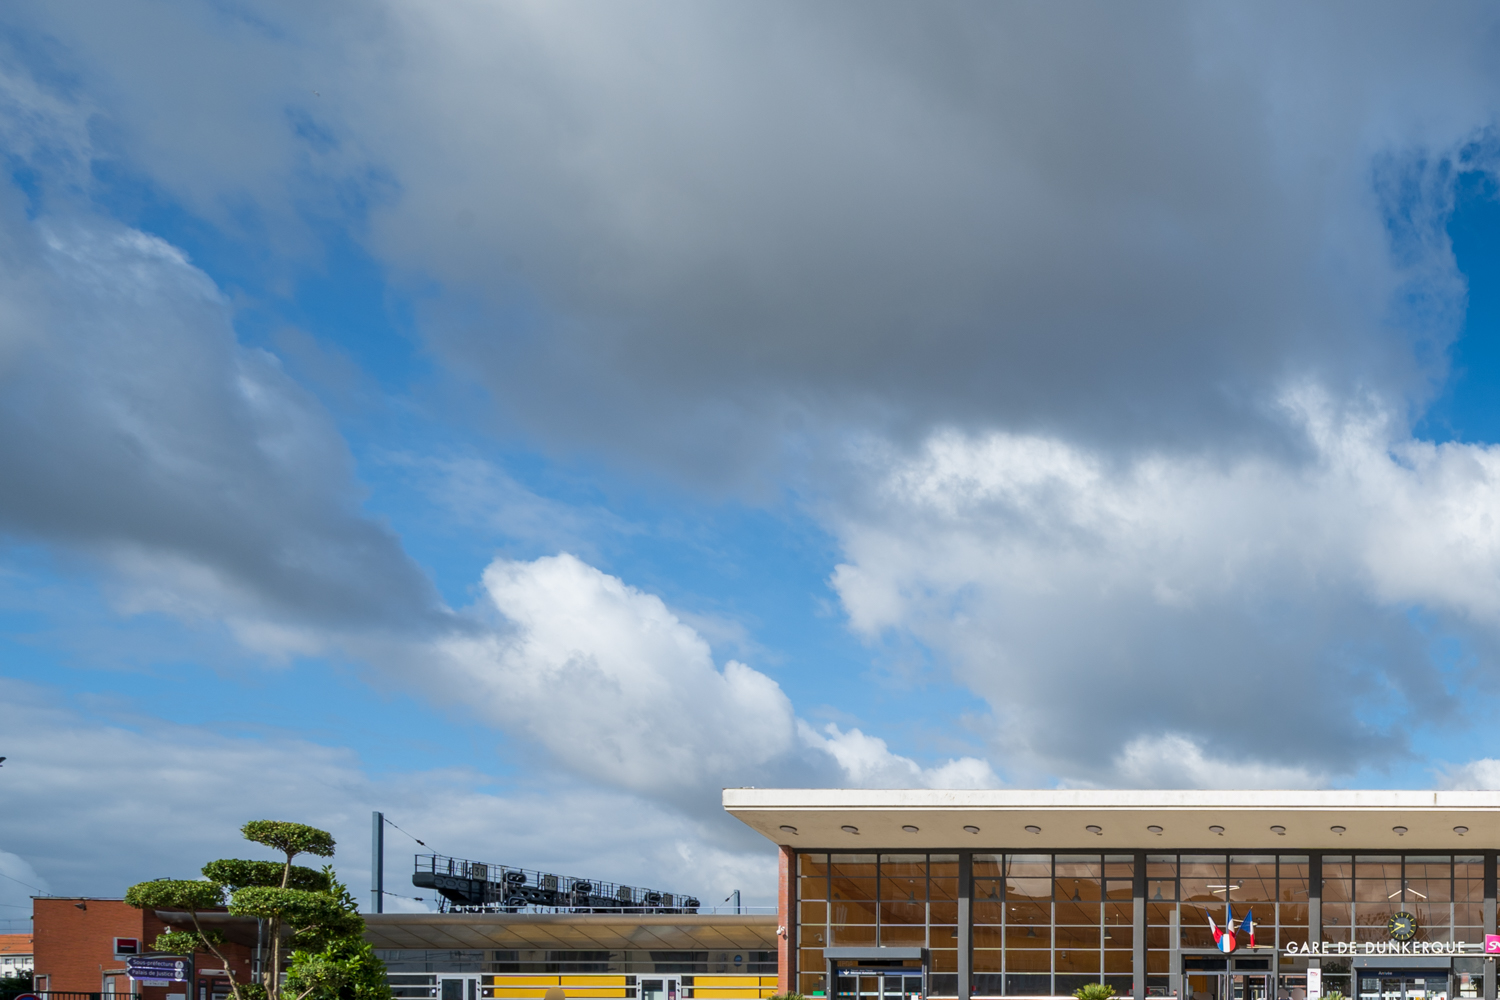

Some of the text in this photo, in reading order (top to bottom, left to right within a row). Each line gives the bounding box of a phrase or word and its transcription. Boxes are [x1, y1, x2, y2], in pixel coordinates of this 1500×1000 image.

[475, 866, 485, 877] 30
[546, 878, 556, 888] 30
[1286, 941, 1466, 955] GARE DE DUNKERQUE
[133, 959, 174, 967] Sous-préfecture
